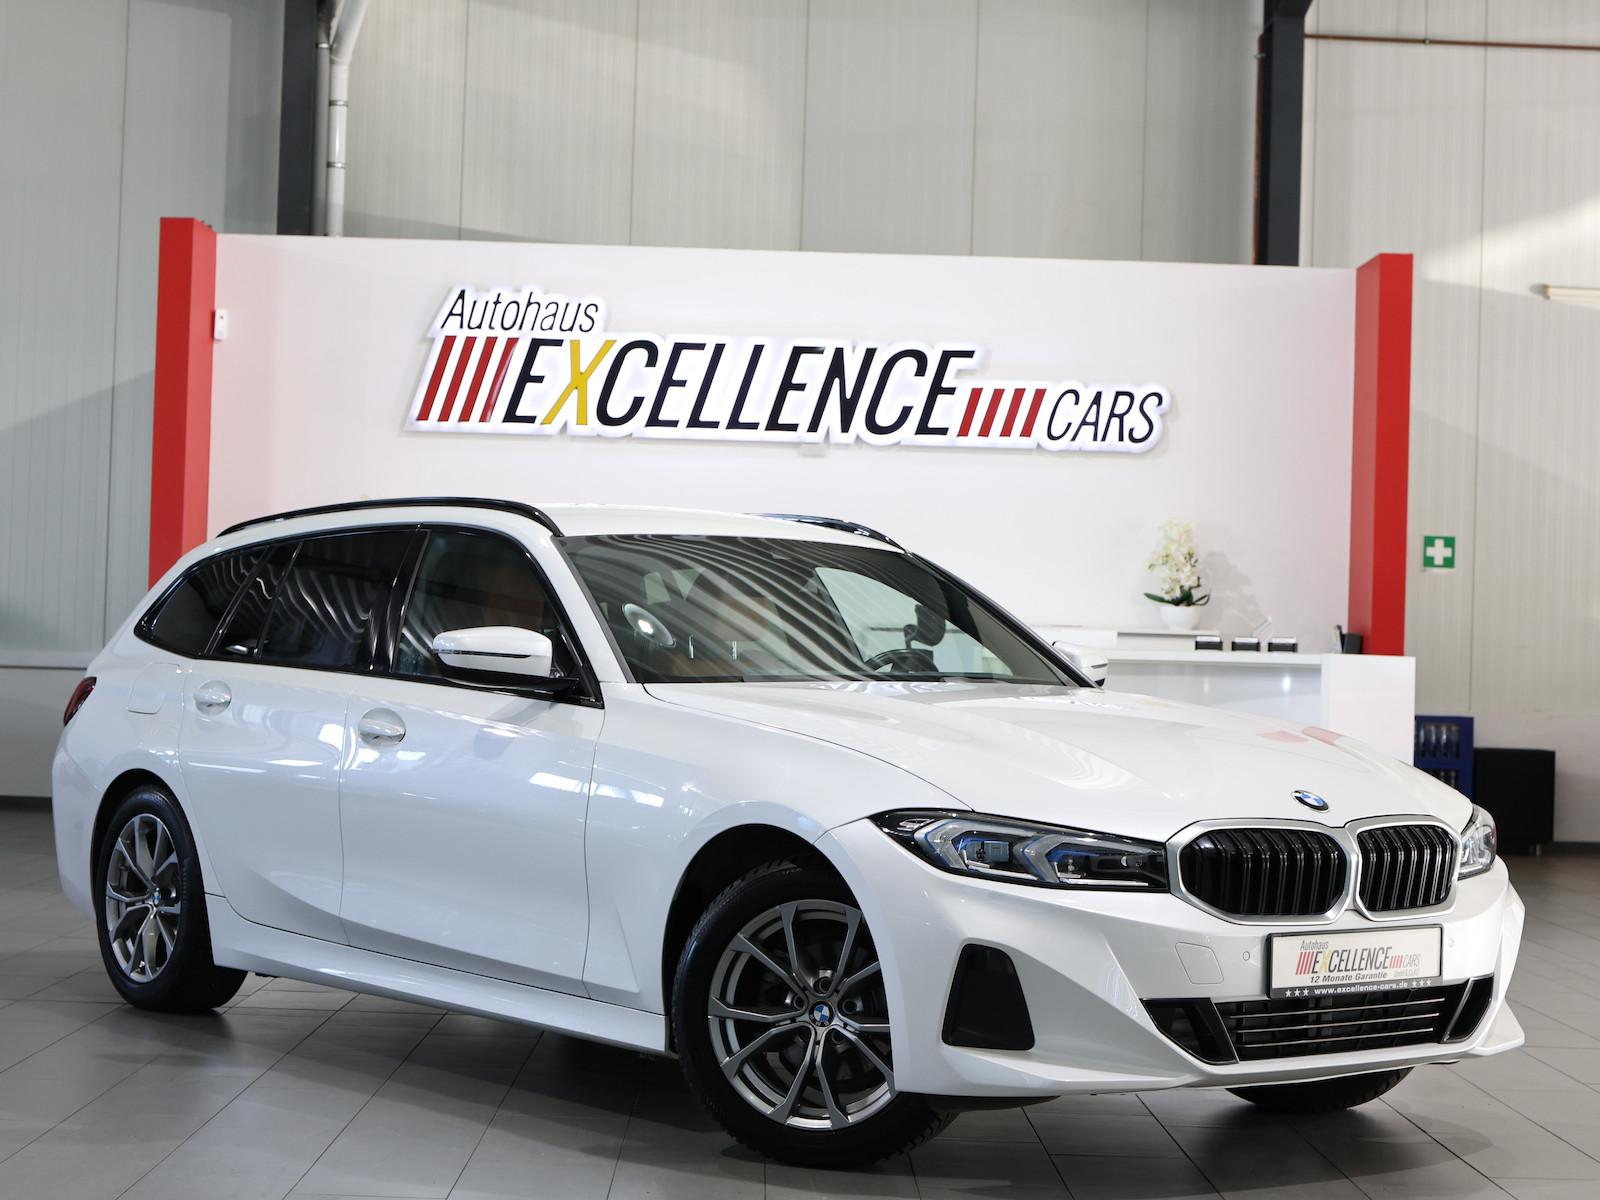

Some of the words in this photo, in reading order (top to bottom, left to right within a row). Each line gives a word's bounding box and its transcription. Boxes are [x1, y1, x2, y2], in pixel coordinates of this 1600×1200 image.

[441, 289, 598, 332] Autohaus
[502, 338, 975, 435] EXCELLENCE
[1047, 389, 1163, 443] CARS
[1300, 939, 1329, 950] Autohaus
[1311, 946, 1392, 974] EXCELLENCE
[1403, 953, 1421, 968] CARS
[1310, 975, 1320, 983] 12
[1322, 974, 1352, 983] Monate
[1355, 971, 1387, 980] Garantie
[1314, 981, 1408, 995] www.excellence-cars.de
